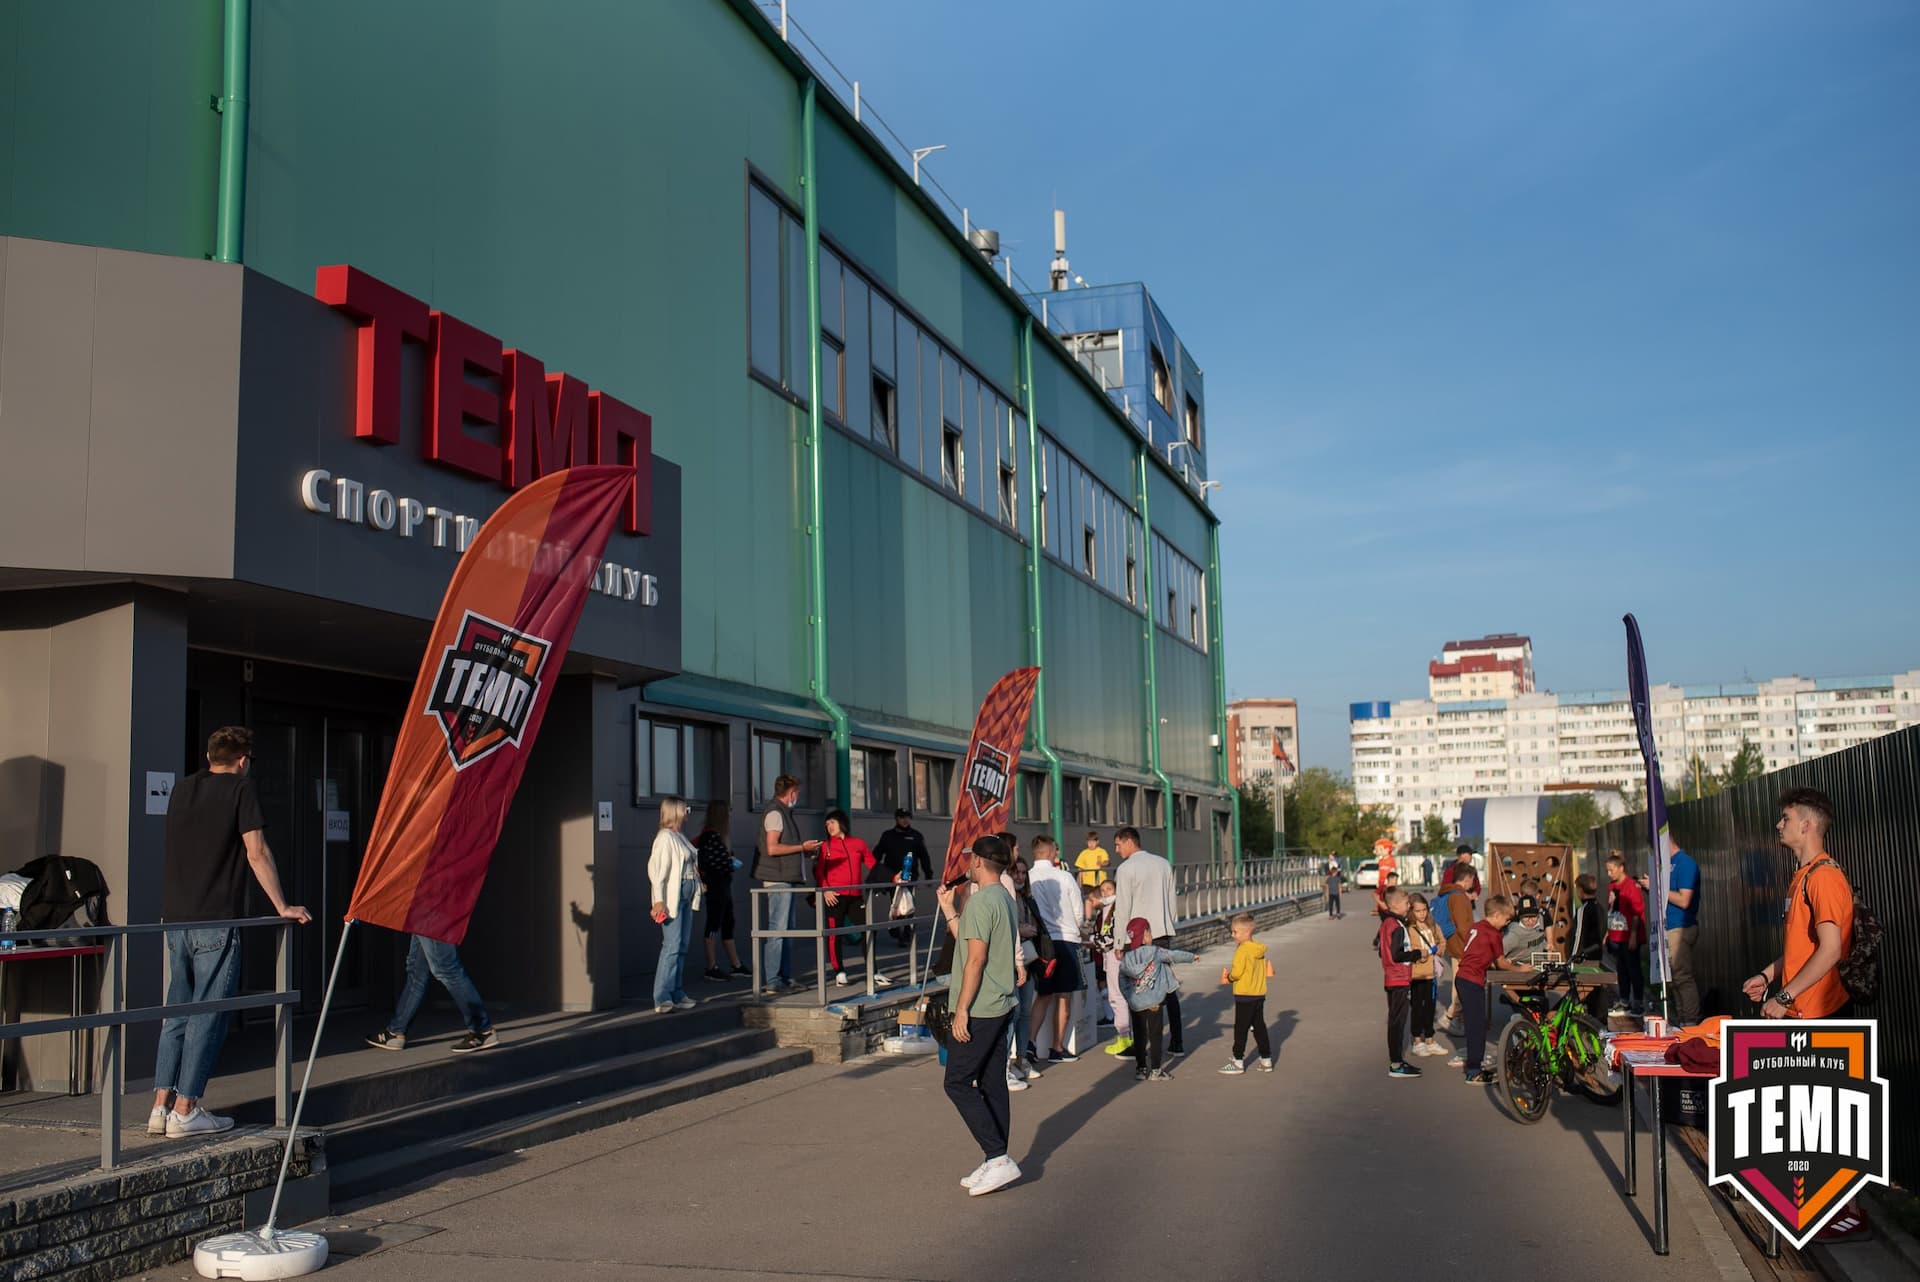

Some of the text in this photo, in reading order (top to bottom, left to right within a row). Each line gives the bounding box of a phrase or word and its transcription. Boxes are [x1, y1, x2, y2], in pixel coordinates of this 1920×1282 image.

[315, 264, 652, 536] ТЕМП
[444, 658, 531, 728] ТЕМП
[972, 763, 1006, 798] ТЕМП
[1463, 928, 1478, 952] 7
